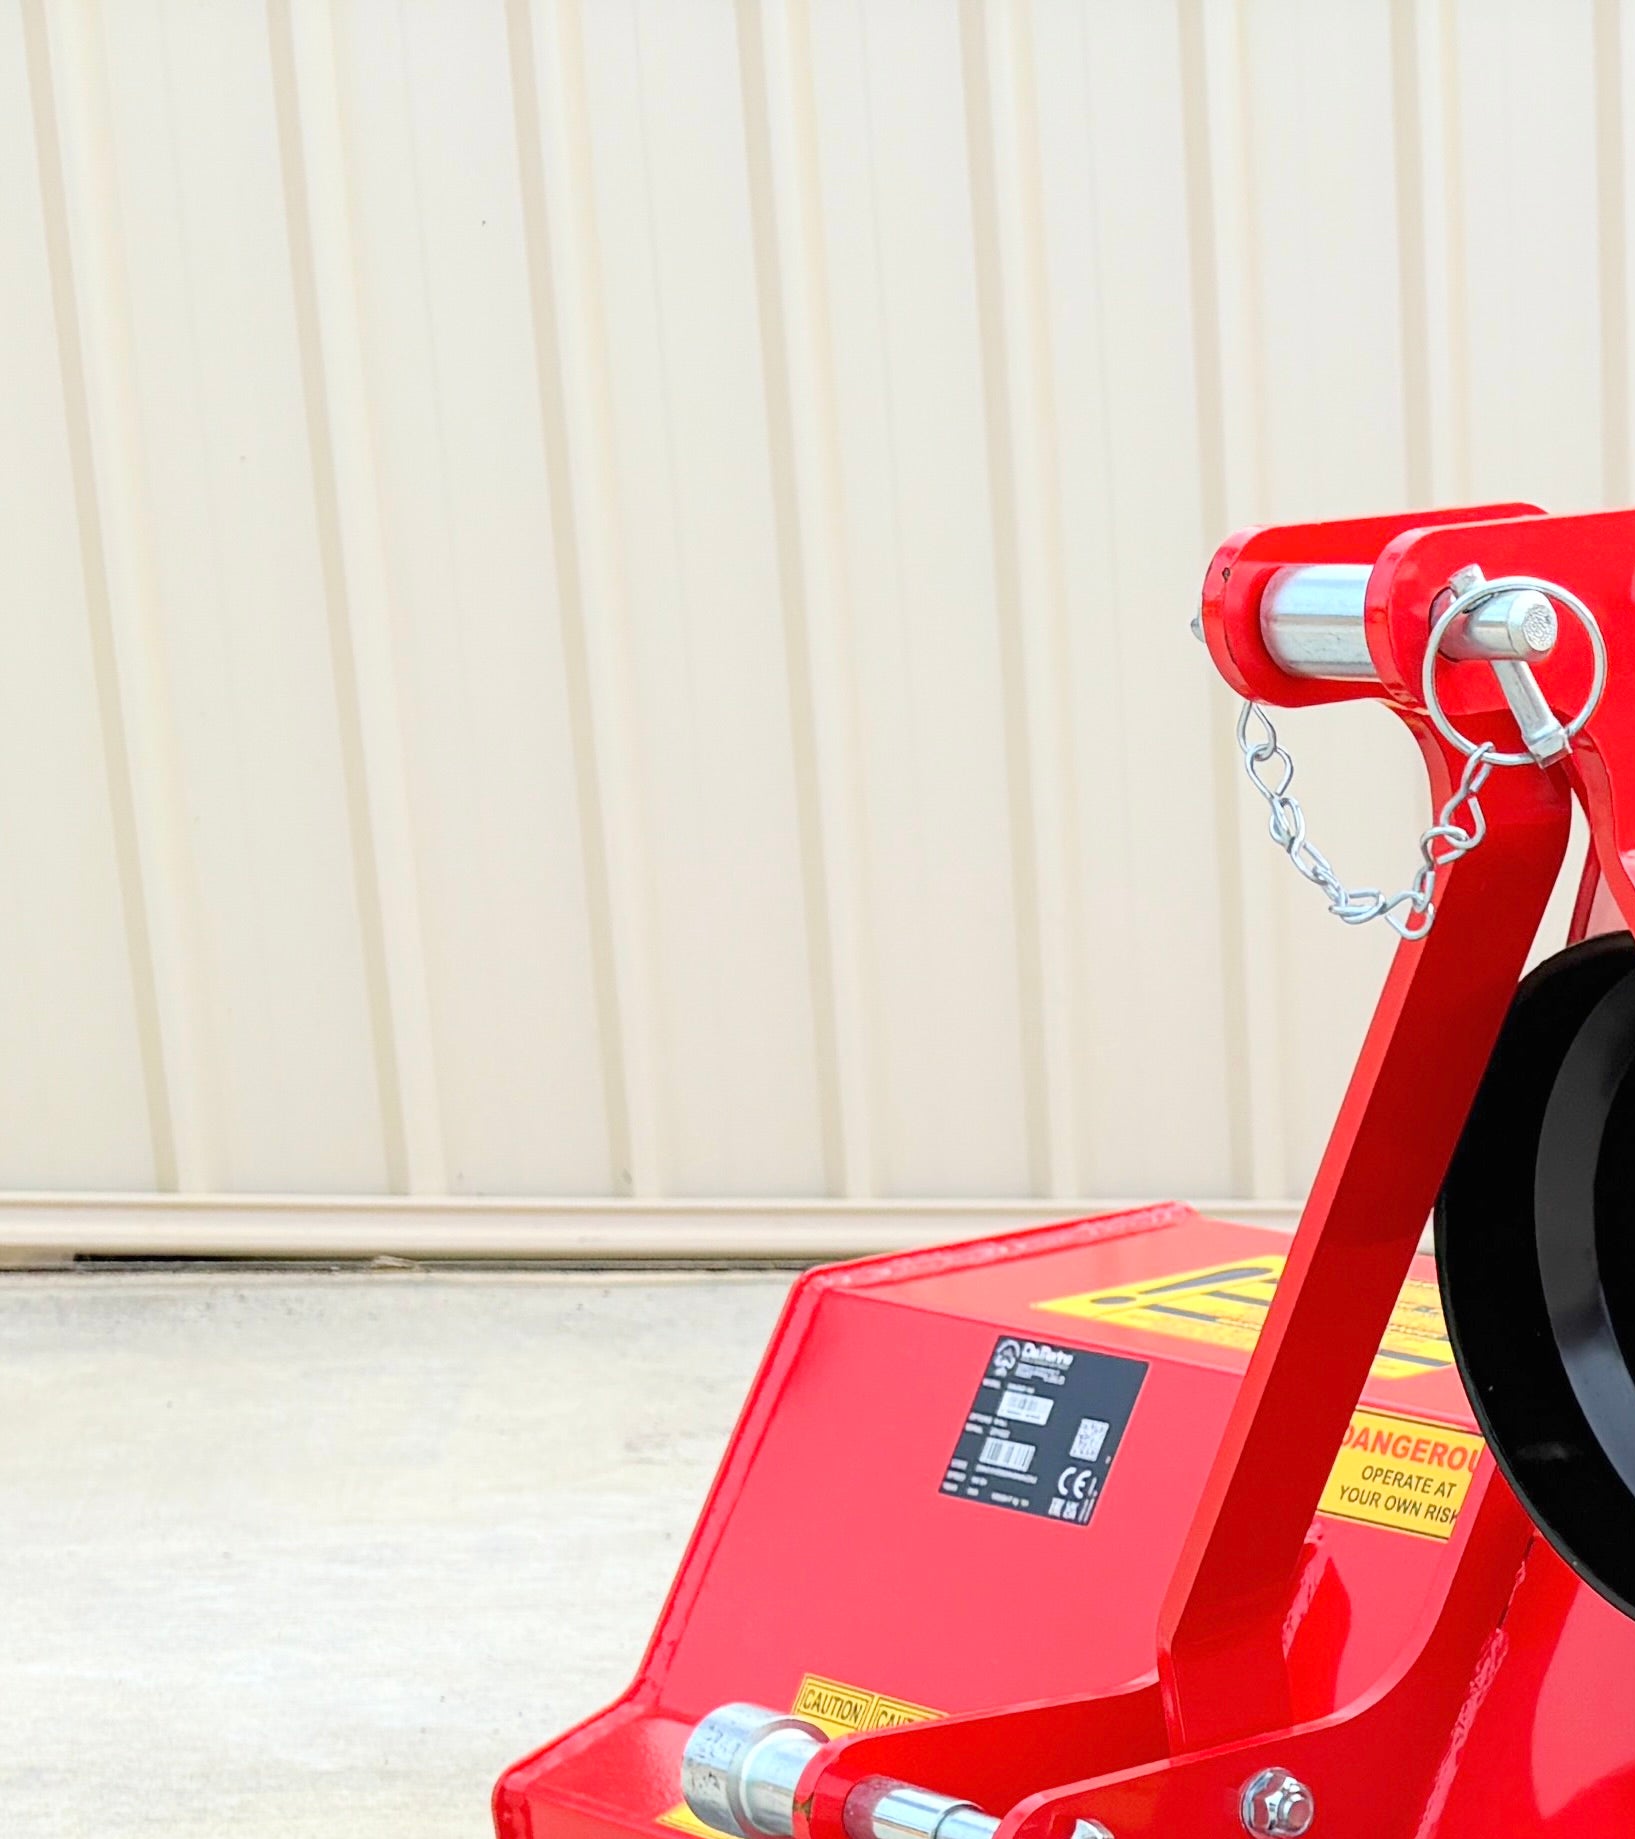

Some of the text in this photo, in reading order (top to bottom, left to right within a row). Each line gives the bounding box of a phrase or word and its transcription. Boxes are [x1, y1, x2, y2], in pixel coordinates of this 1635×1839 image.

[1361, 1465, 1457, 1498] OPERATE AT
[1340, 1485, 1381, 1508] YOUR
[1384, 1495, 1423, 1517] OWN
[803, 1689, 863, 1724] CAUTION
